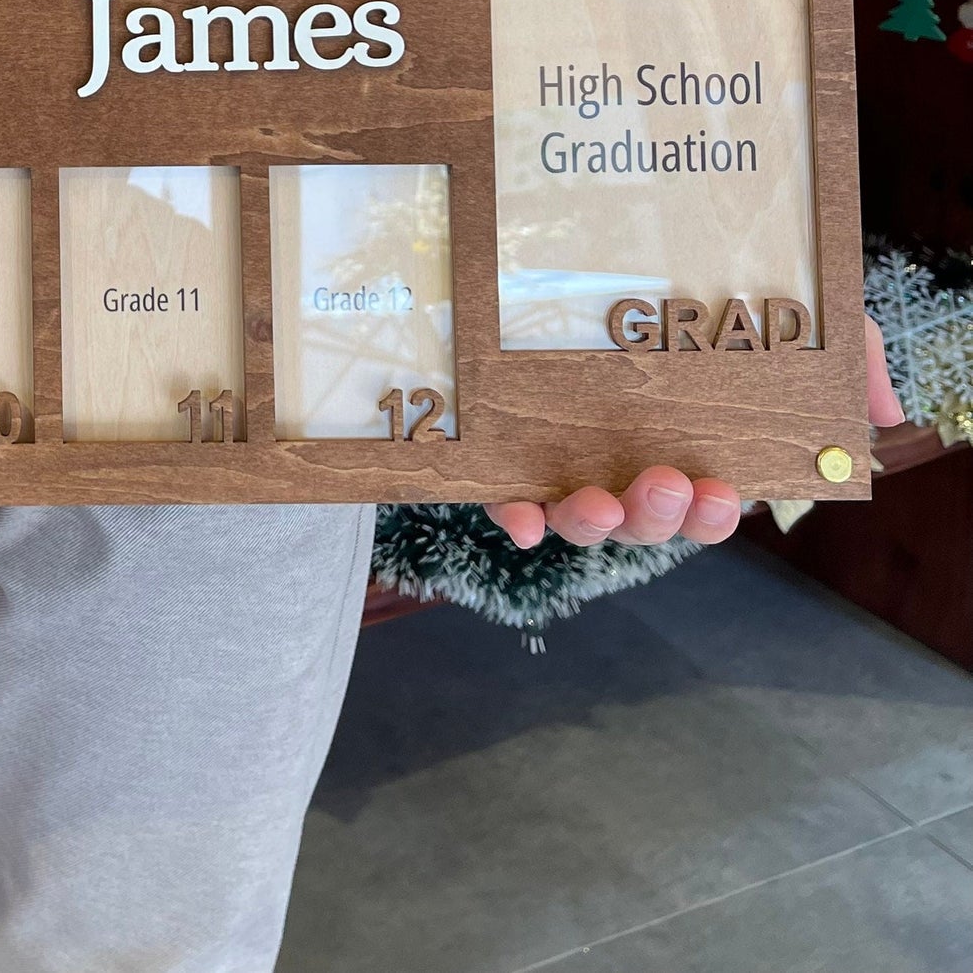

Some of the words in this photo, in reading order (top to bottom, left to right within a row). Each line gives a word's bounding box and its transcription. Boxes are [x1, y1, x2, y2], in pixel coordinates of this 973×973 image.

[540, 63, 622, 119] High
[637, 61, 761, 105] School
[541, 130, 756, 173] Graduation
[104, 287, 168, 312] Grade
[177, 288, 198, 311] 11
[313, 287, 382, 311] Grade
[388, 286, 413, 310] 12
[606, 298, 812, 352] GRAD
[177, 389, 233, 443] 11
[379, 388, 446, 441] 12
